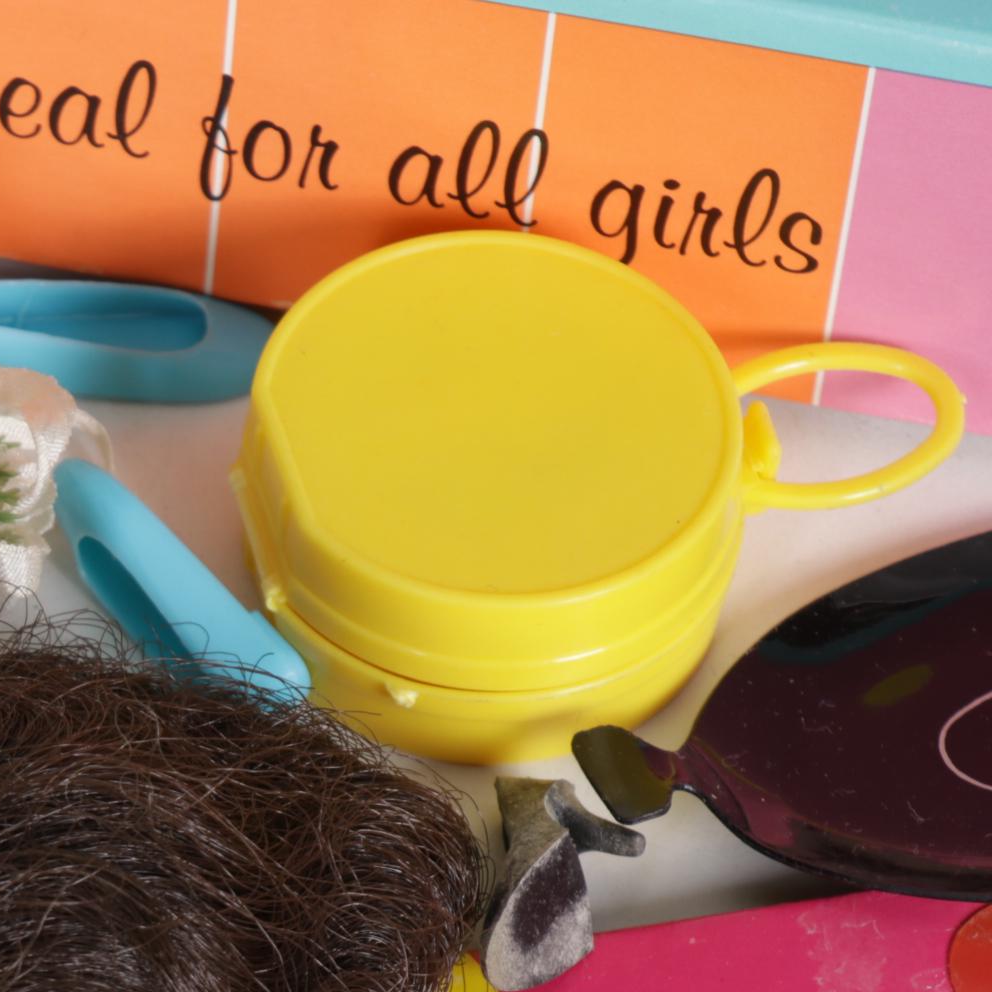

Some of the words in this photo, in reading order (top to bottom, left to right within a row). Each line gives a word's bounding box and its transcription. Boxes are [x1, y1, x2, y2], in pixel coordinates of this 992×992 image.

[200, 73, 340, 201] for
[387, 119, 549, 228] all
[589, 168, 823, 274] girls
